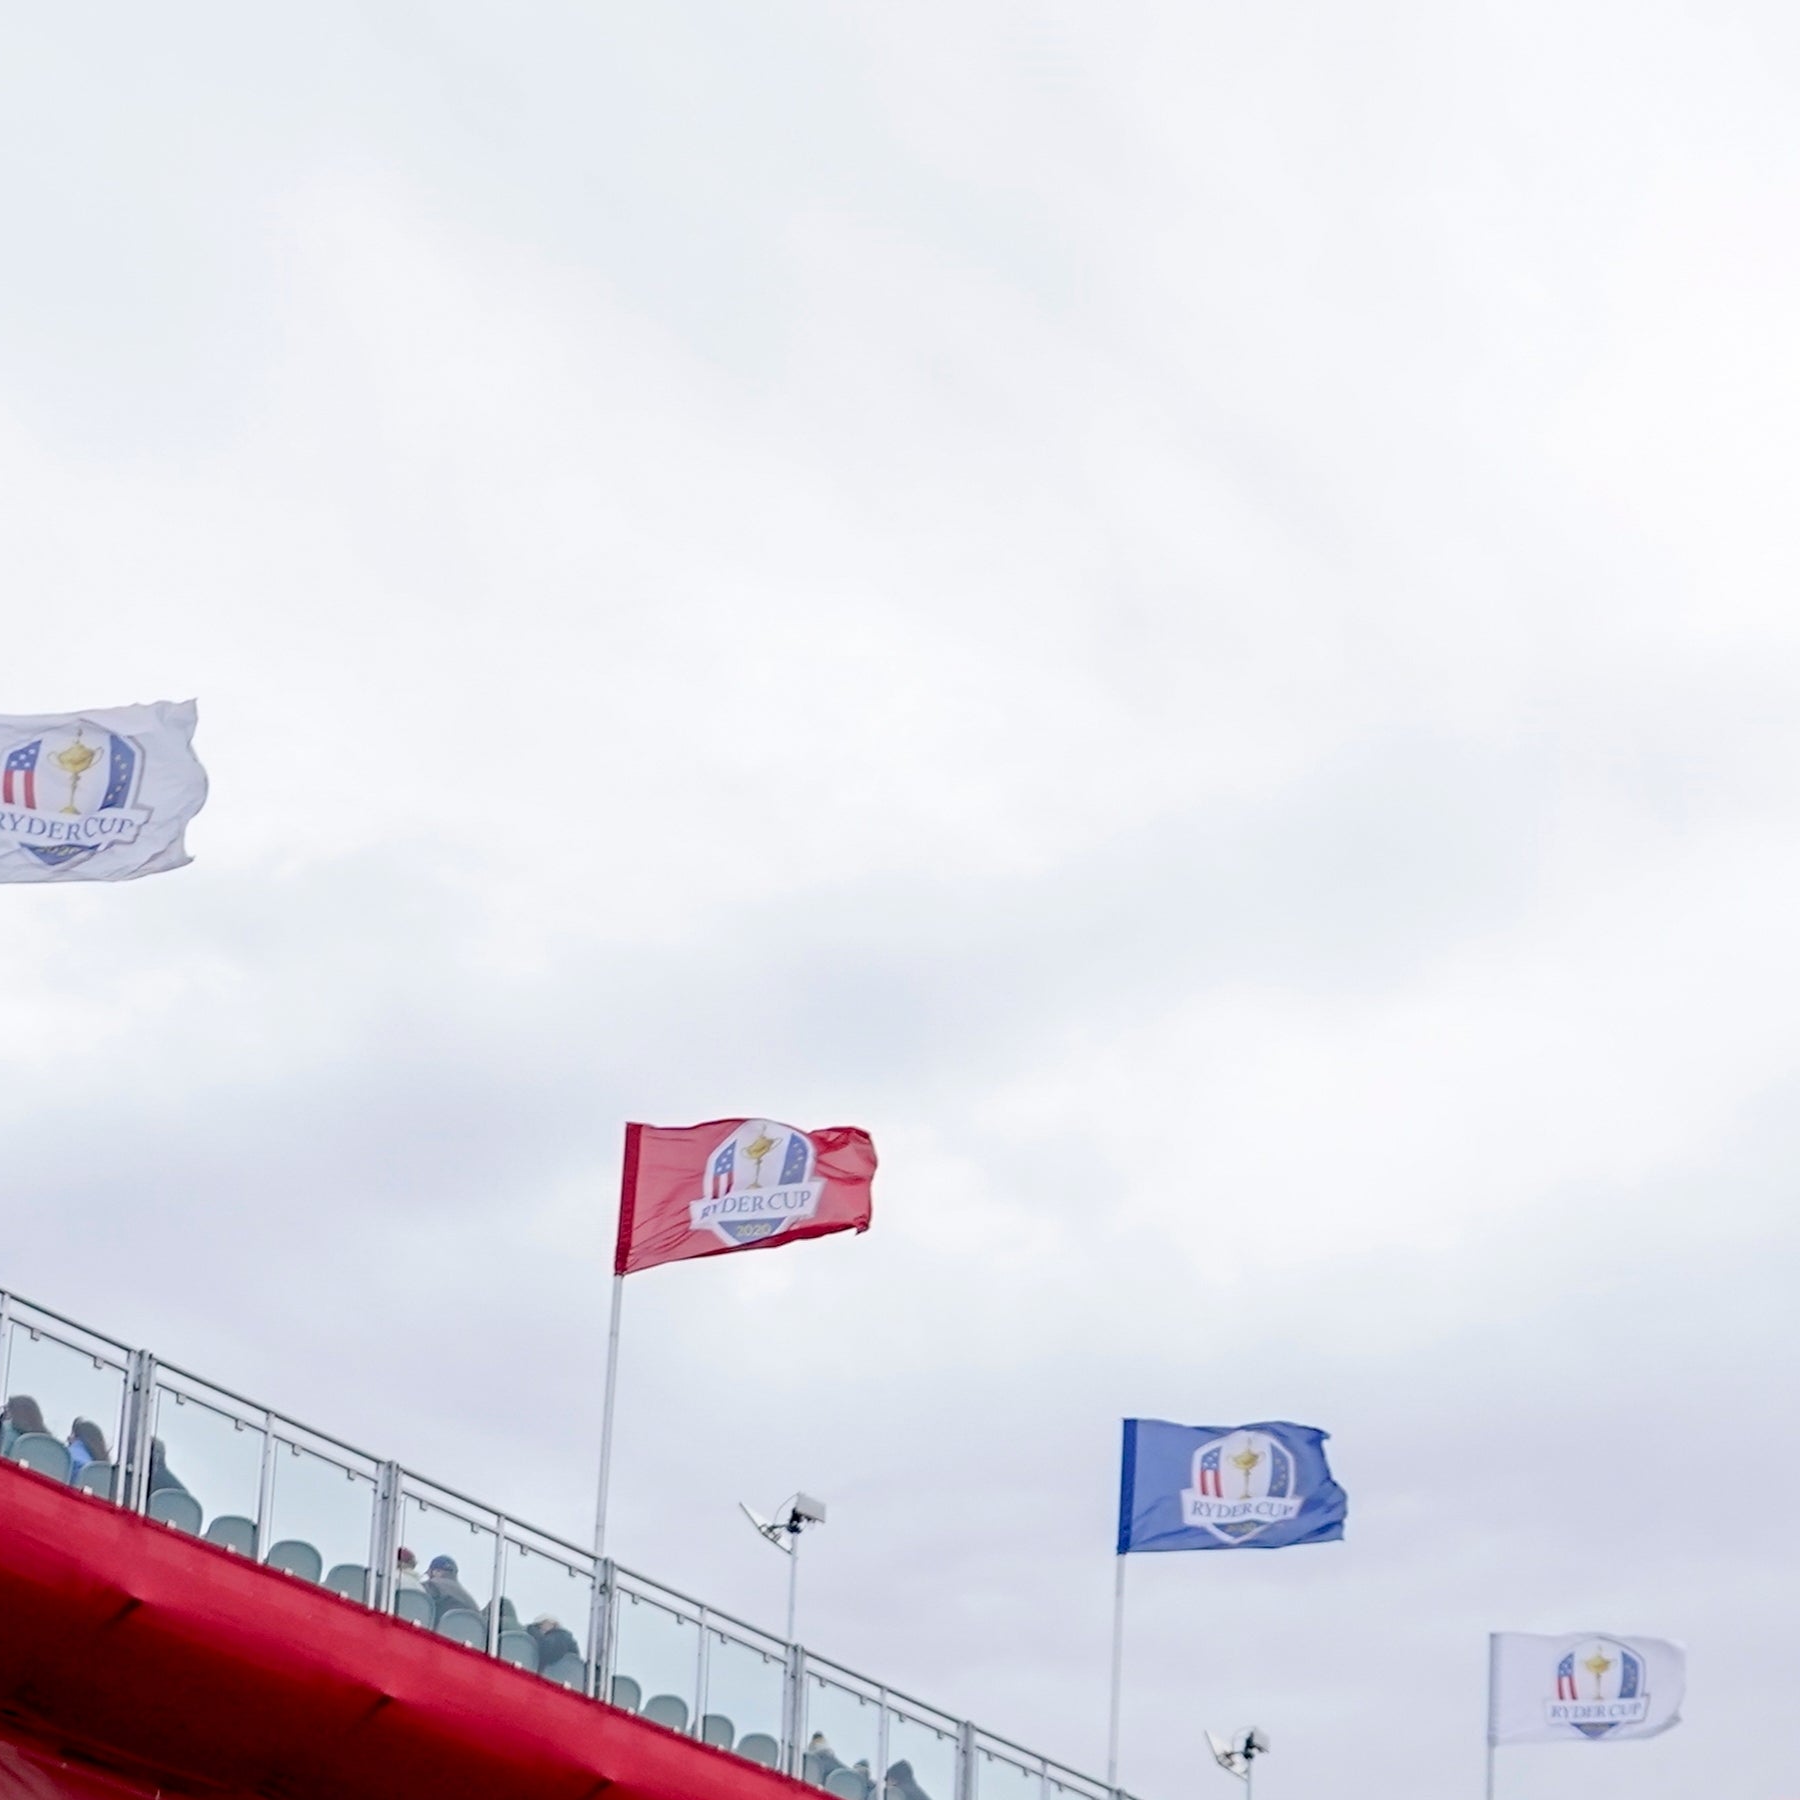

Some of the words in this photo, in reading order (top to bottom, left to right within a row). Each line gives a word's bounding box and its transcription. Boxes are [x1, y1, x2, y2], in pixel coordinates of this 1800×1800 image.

[83, 816, 135, 839] CUP
[701, 1196, 765, 1220] RYDER
[767, 1190, 812, 1211] CUP
[736, 1223, 772, 1236] 2020
[1192, 1500, 1251, 1518] RYDER
[1255, 1501, 1294, 1517] CUP
[1551, 1704, 1606, 1718] RYDER
[1609, 1702, 1642, 1717] CUP
